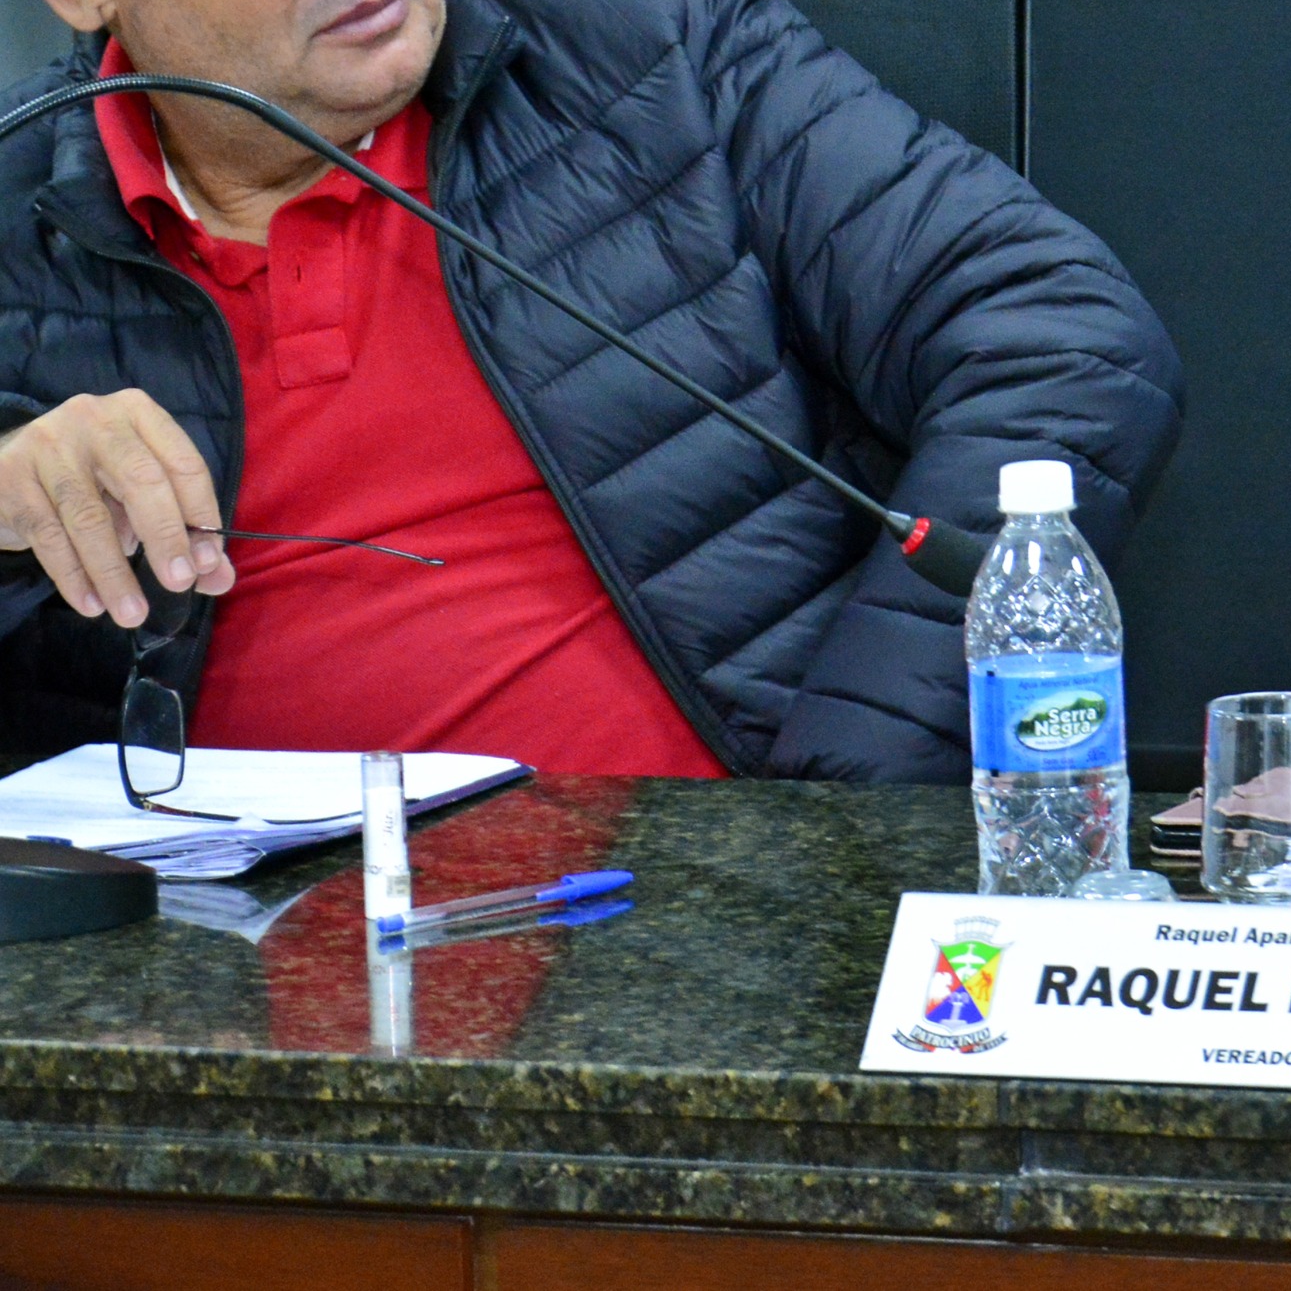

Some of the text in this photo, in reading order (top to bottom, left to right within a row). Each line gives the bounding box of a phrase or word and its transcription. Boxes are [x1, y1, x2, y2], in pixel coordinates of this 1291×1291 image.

[1047, 707, 1097, 724] Serra
[1033, 719, 1092, 739] Negra
[1155, 923, 1238, 946] Raquel
[1035, 965, 1268, 1016] RAQUEL
